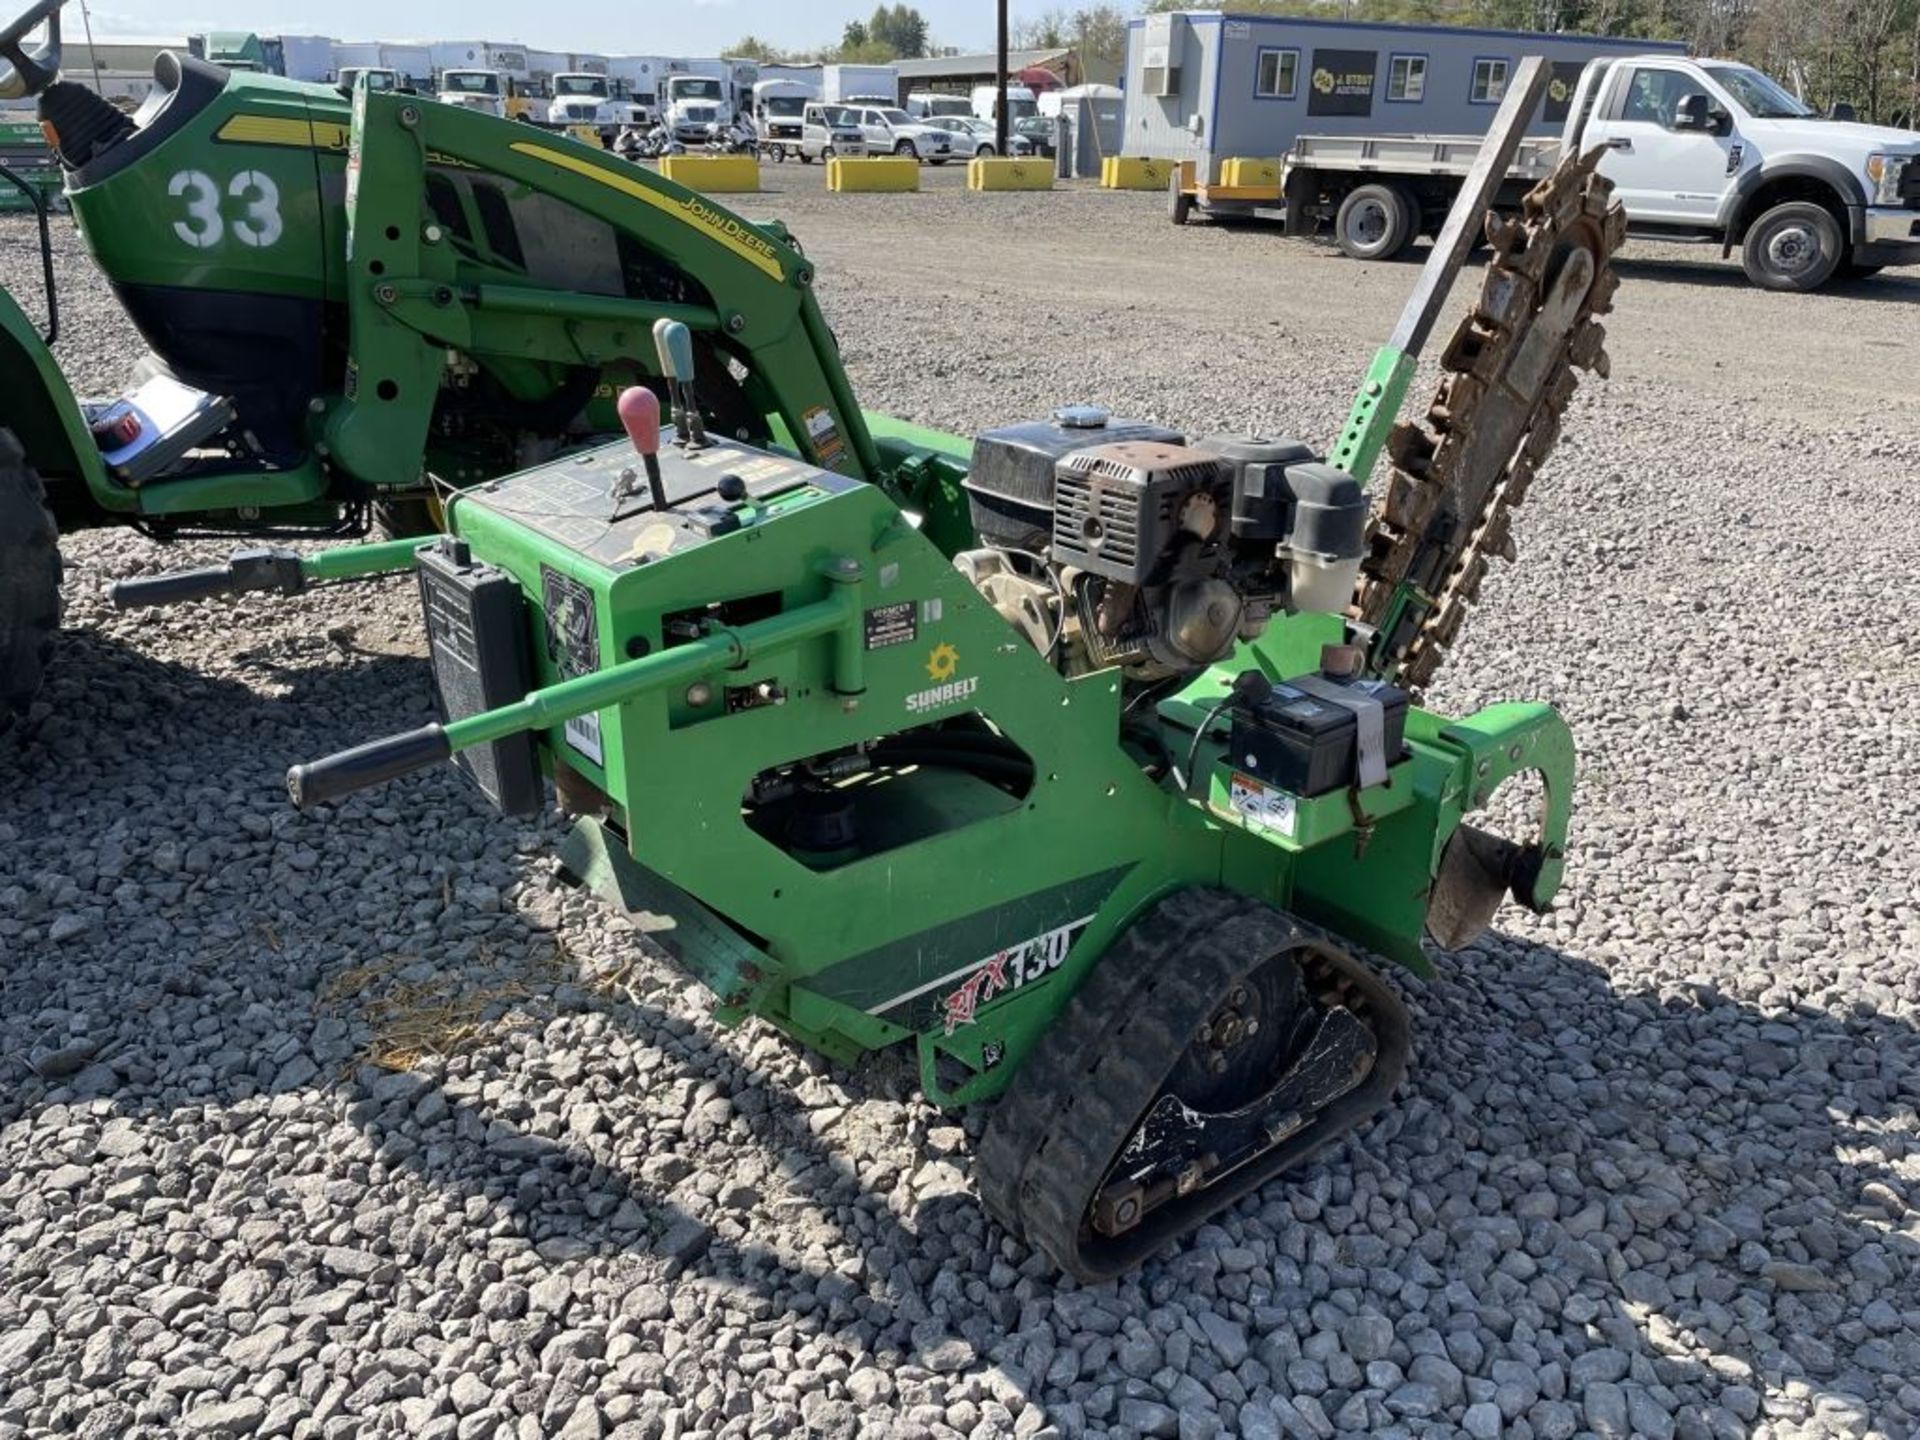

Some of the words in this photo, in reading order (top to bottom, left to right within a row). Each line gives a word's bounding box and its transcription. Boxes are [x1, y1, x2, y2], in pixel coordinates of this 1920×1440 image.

[168, 169, 283, 248] 33
[680, 197, 725, 230] JOHN
[722, 218, 777, 259] DEERE
[904, 675, 979, 711] SUNBELT
